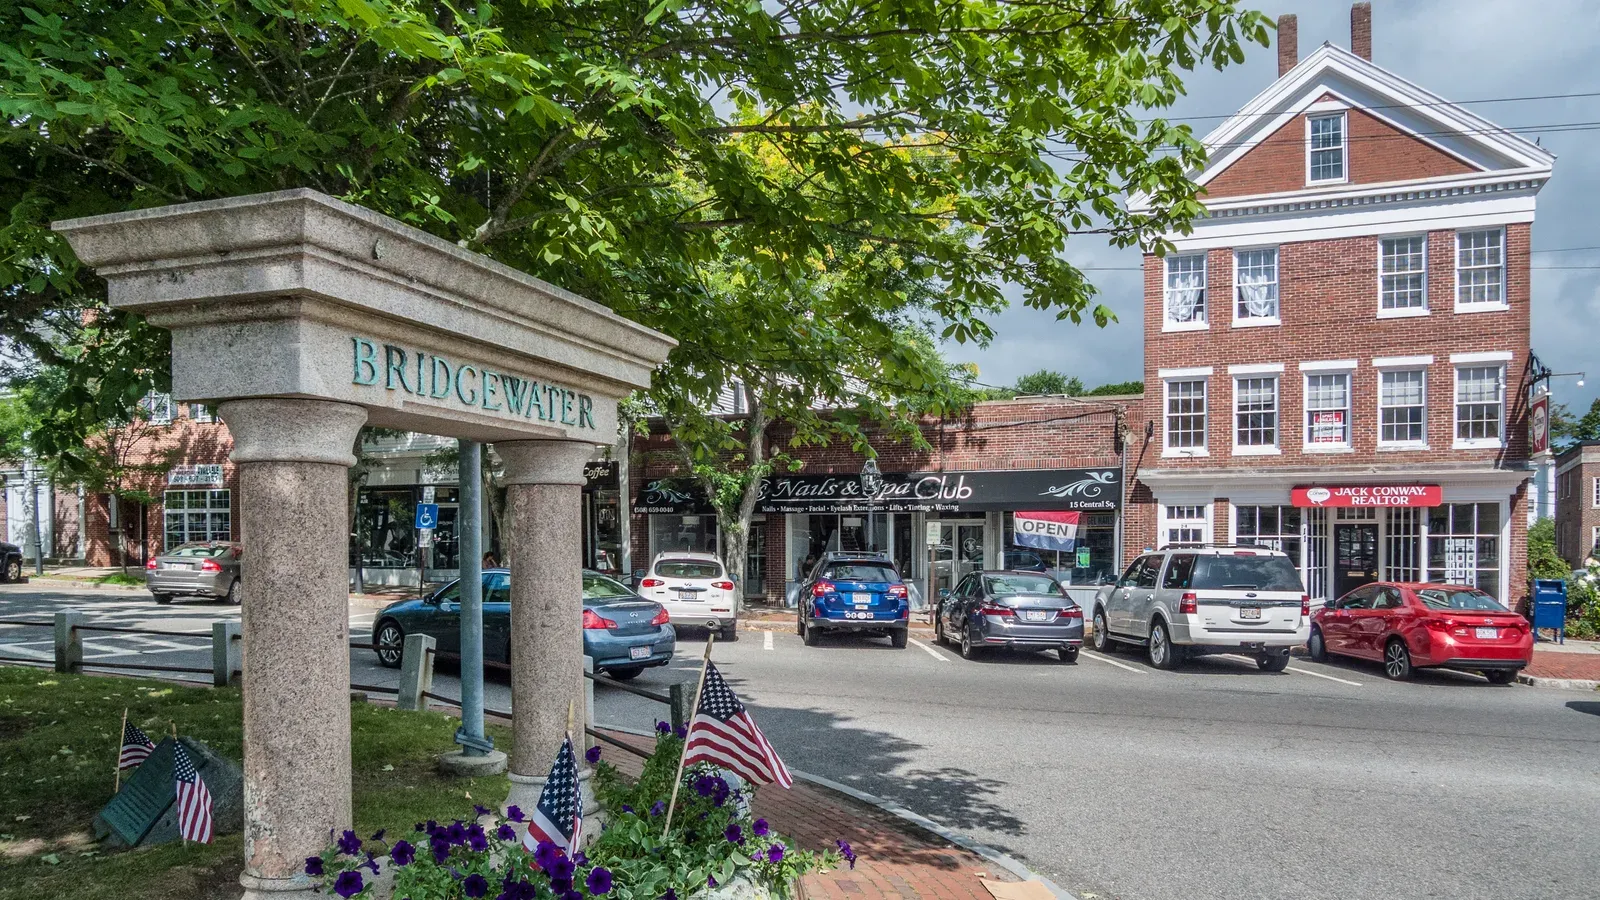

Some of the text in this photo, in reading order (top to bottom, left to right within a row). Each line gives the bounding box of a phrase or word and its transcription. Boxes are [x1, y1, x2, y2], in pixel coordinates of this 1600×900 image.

[351, 336, 596, 430] BRIDGEWATER
[583, 466, 610, 480] Coffee
[771, 478, 839, 497] Nails
[840, 480, 861, 496] &
[914, 475, 973, 499] Club
[1334, 487, 1369, 496] JACK
[1105, 500, 1116, 509] Sq.
[1351, 496, 1409, 505] REALTOR
[780, 505, 804, 513] Massage
[830, 504, 853, 512] Eyelash
[907, 504, 931, 512] Tinting
[935, 503, 959, 511] Waxing
[1022, 520, 1069, 537] OPEN
